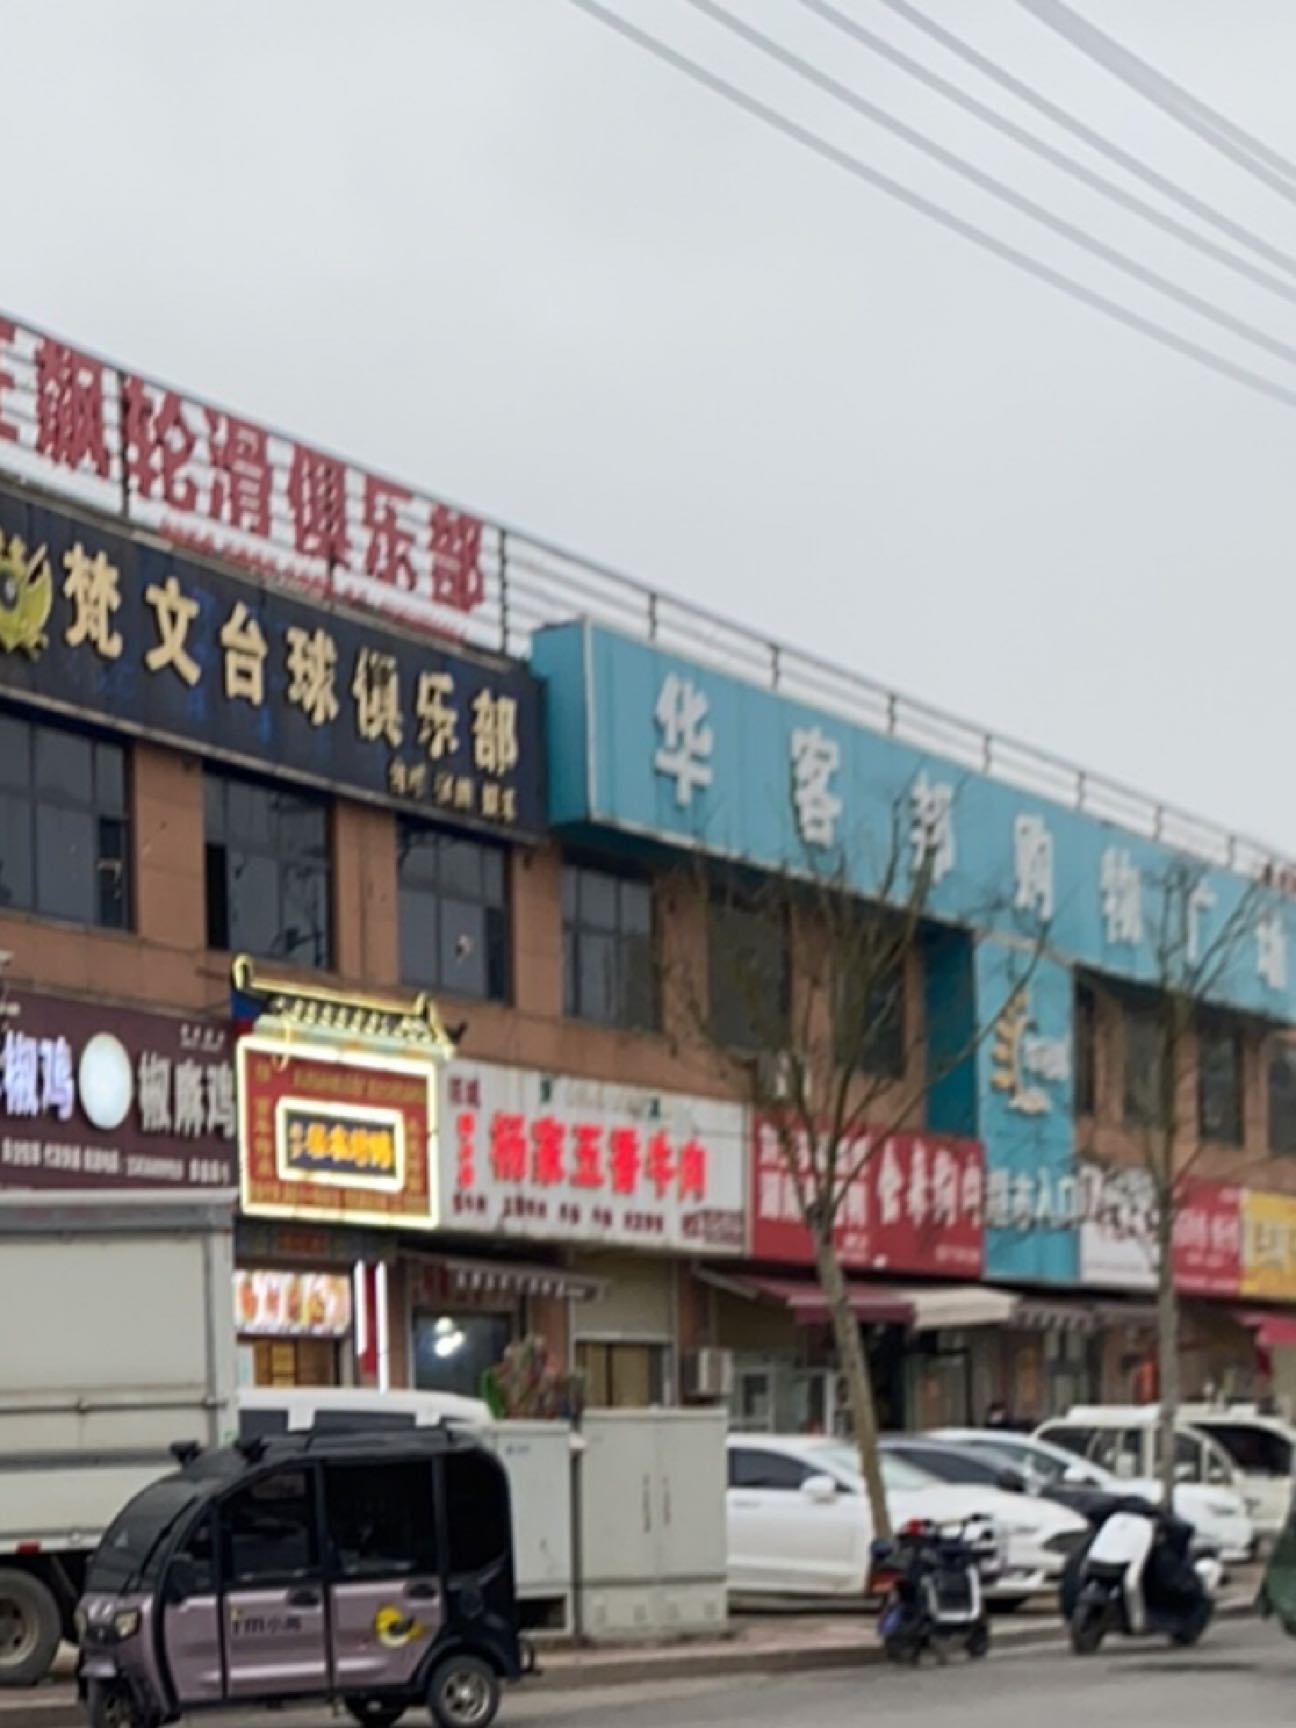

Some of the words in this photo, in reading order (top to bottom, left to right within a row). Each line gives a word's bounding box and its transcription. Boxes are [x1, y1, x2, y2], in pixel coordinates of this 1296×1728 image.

[63, 541, 519, 774] 梵文台球俱乐部
